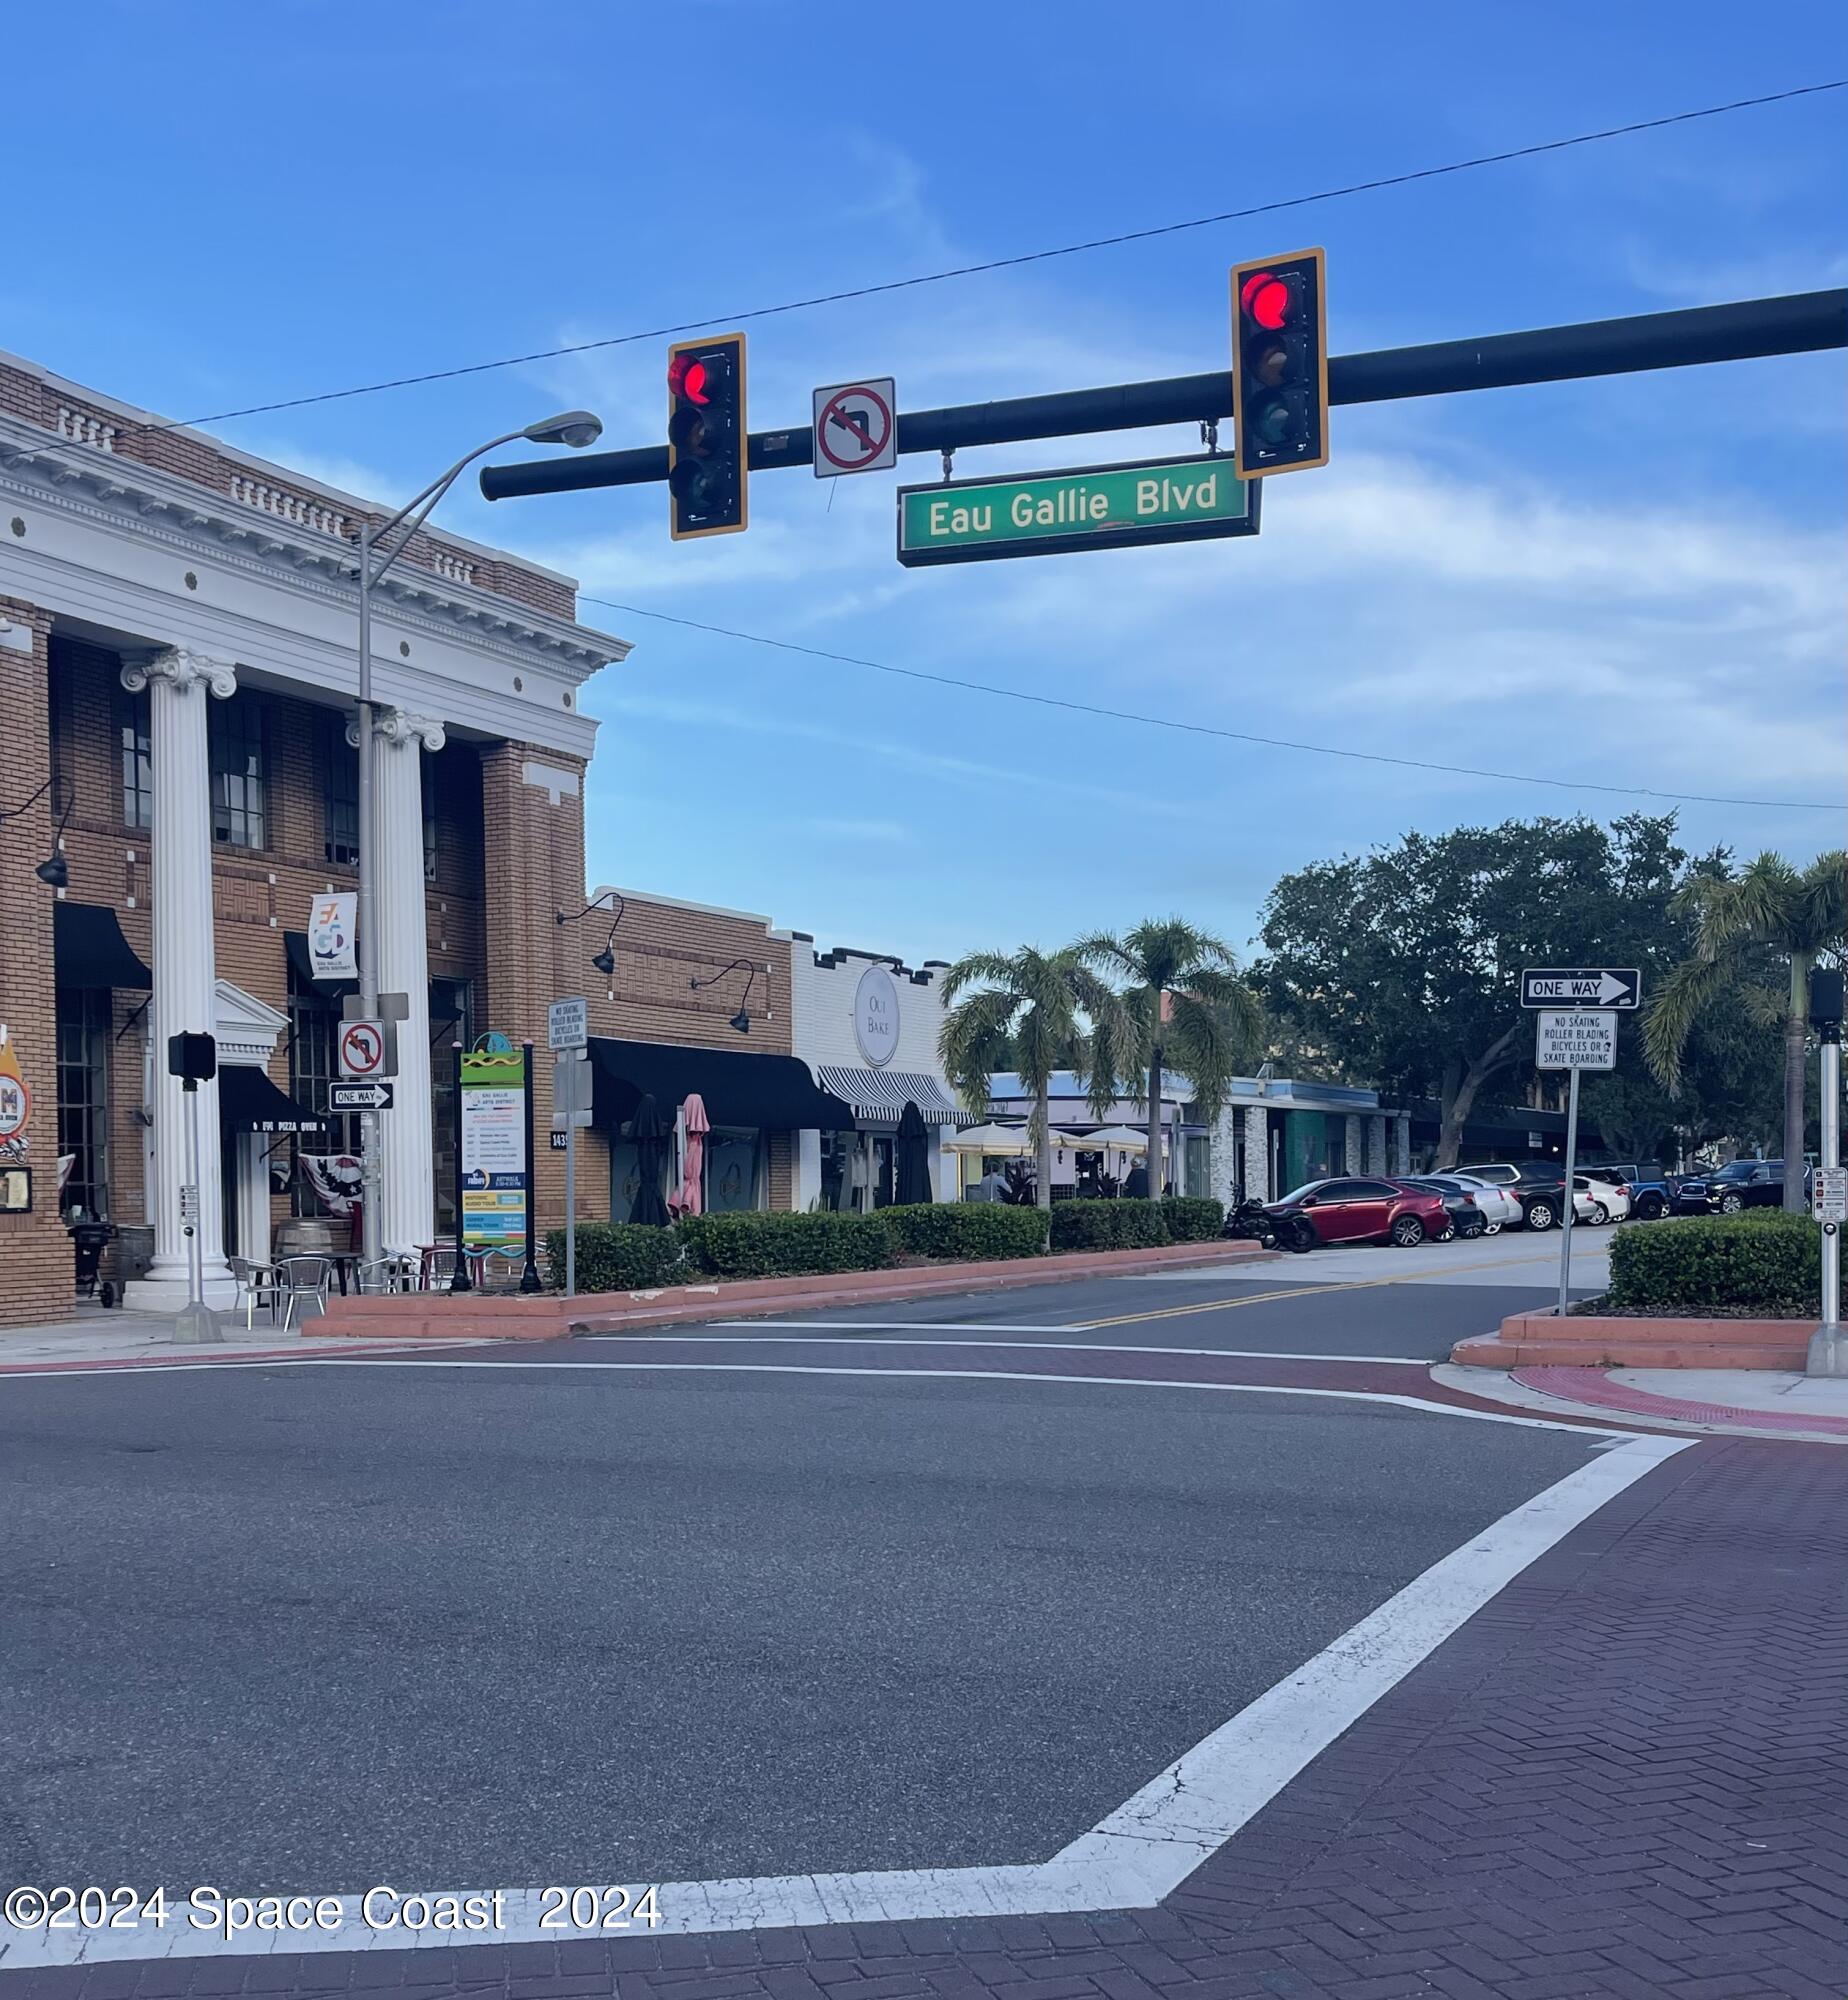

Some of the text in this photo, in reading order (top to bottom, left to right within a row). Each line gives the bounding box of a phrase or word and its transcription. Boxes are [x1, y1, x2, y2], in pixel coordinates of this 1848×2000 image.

[930, 473, 1217, 536] Eau Gallie Blvd
[1533, 981, 1602, 996] ONE WAY
[1555, 1017, 1600, 1028] NO SKATING
[1544, 1029, 1609, 1040] ROLLER BLADING
[1551, 1041, 1601, 1052] BICYCLES OR
[1543, 1053, 1608, 1064] SKATE BOARDING
[337, 1091, 375, 1102] ONE WAY
[278, 1121, 297, 1131] PIZZA
